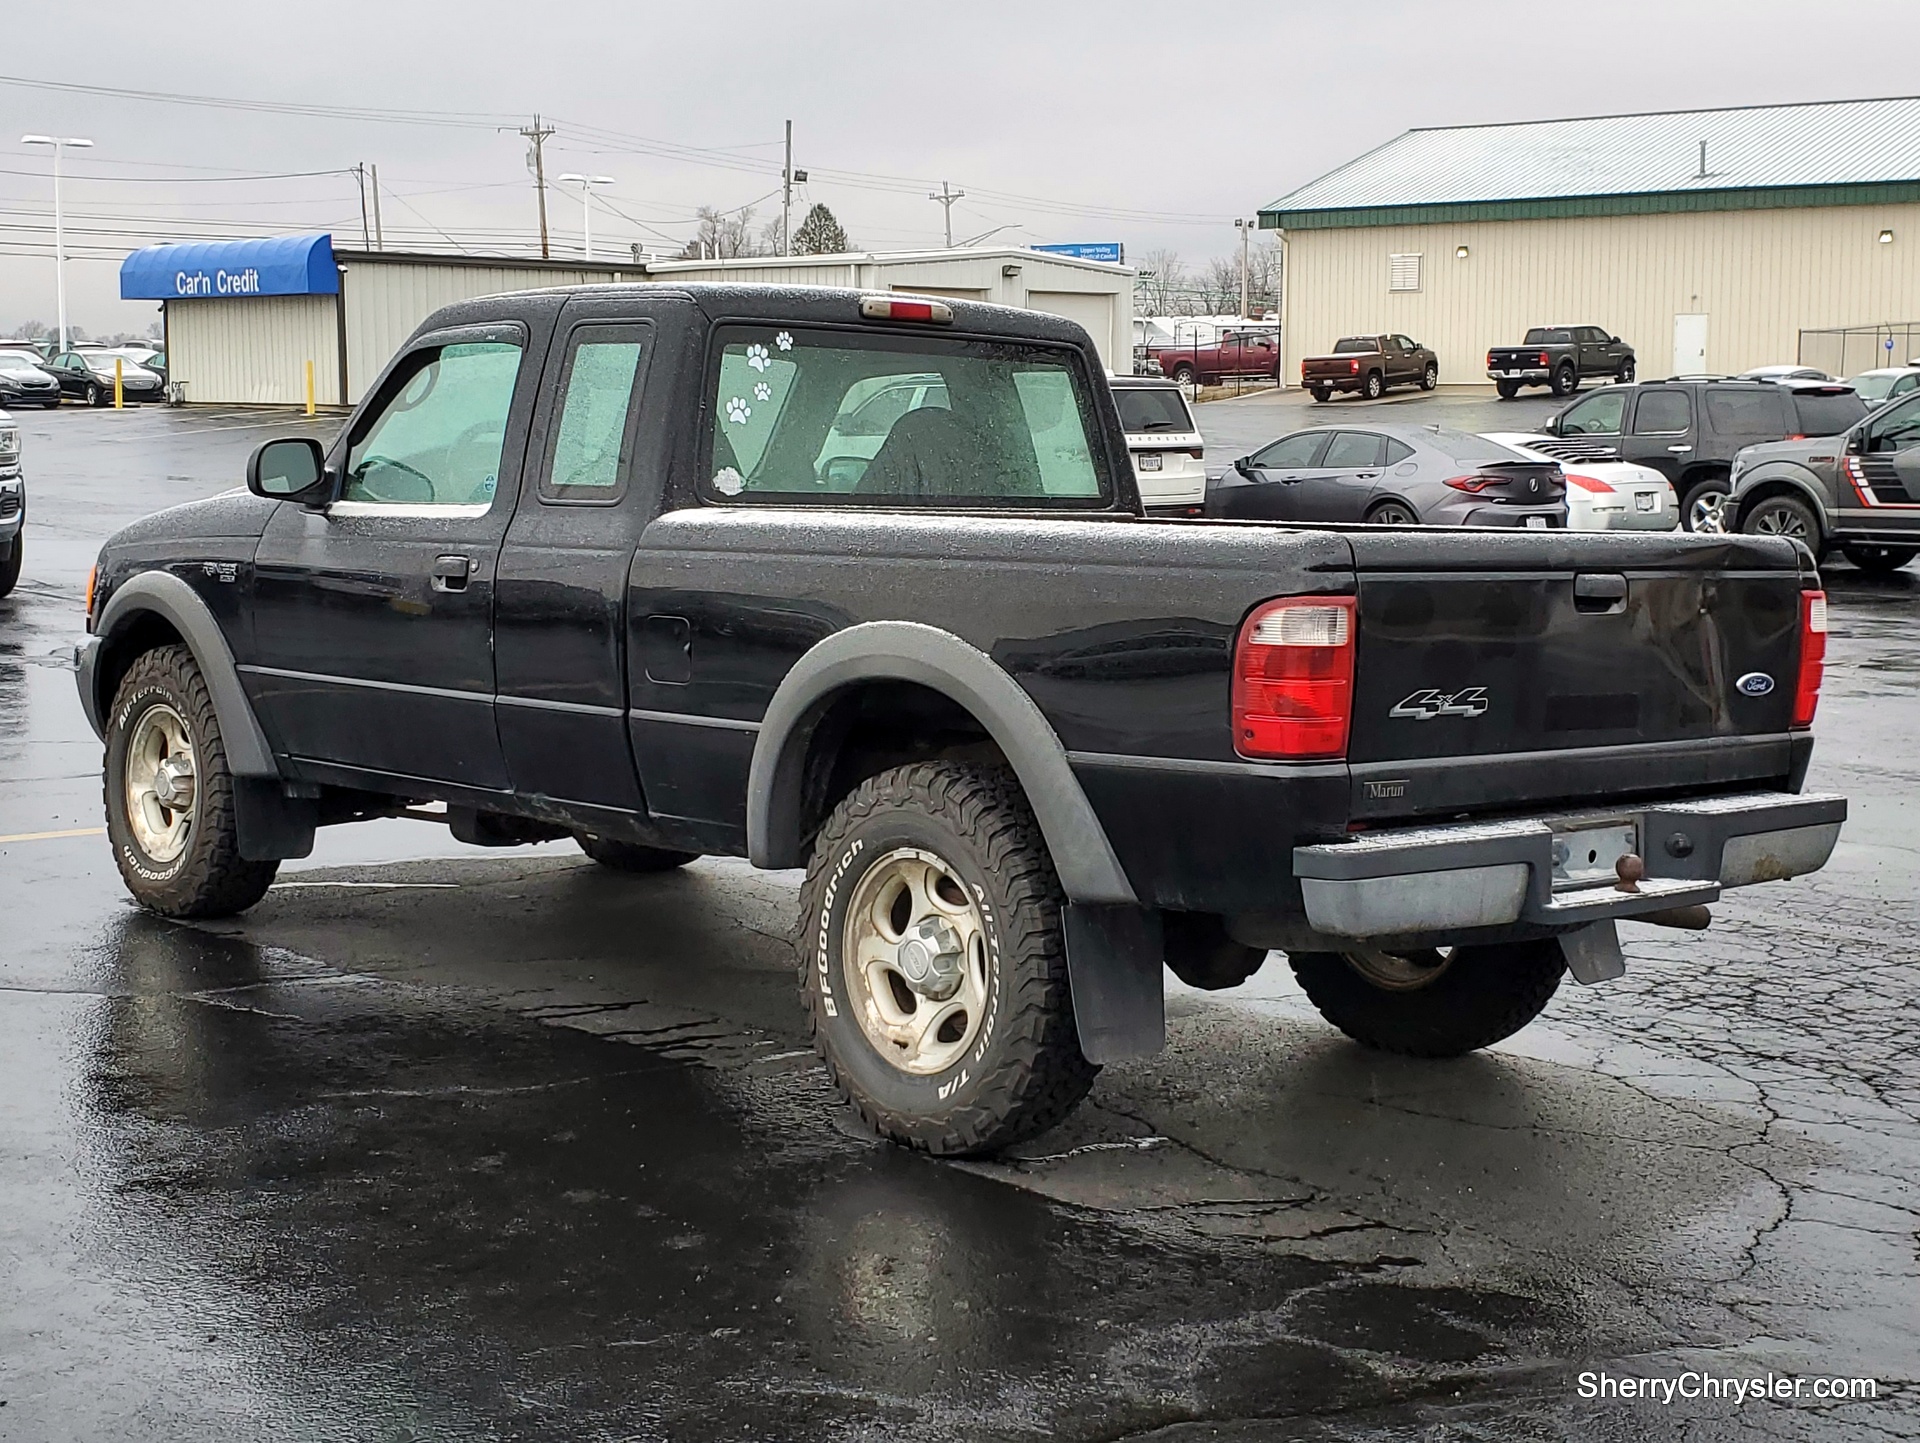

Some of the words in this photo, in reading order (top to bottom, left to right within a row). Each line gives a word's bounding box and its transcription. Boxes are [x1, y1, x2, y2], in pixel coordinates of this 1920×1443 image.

[1095, 246, 1111, 254] Valley
[176, 271, 211, 294] Car'n
[217, 268, 260, 293] Credit
[1746, 678, 1767, 691] Ford
[1389, 686, 1489, 720] 4x4
[816, 838, 865, 1018] BFGoodrich
[937, 1068, 971, 1100] T/A
